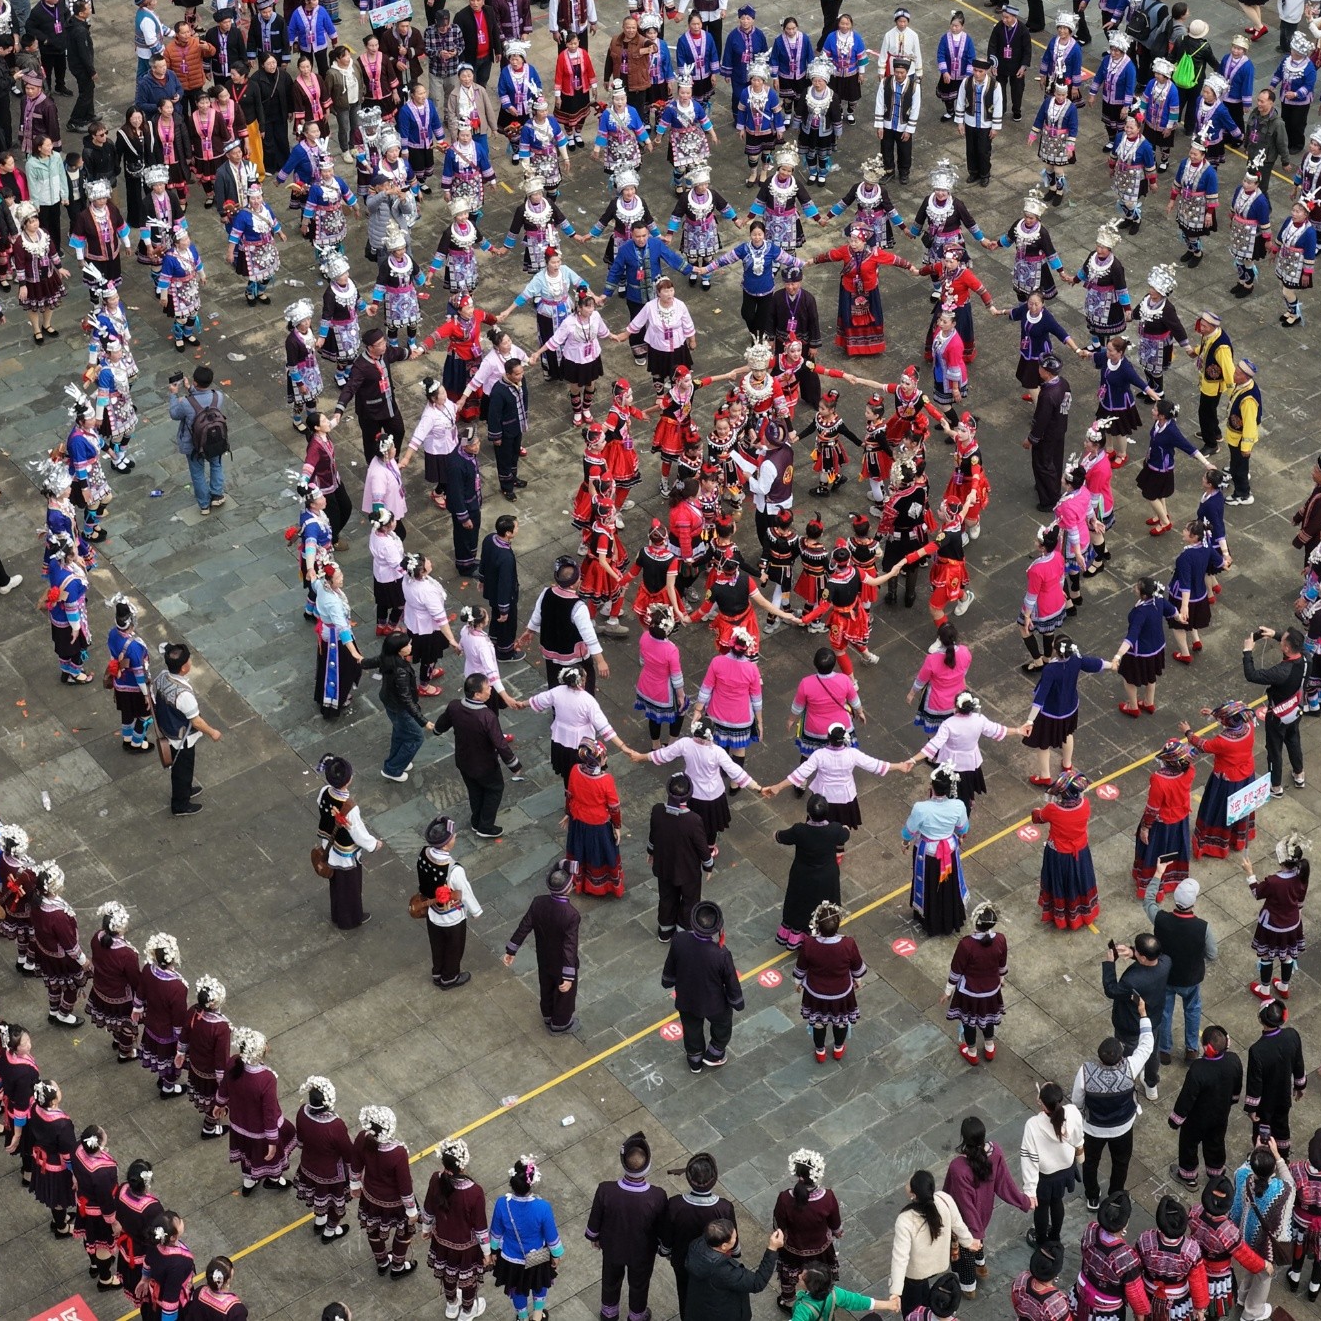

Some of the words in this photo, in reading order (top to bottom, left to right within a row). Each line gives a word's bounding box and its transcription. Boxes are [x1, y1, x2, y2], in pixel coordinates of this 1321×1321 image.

[1099, 785, 1117, 798] 14
[1020, 825, 1038, 840] 15
[895, 940, 915, 954] 17
[761, 971, 780, 987] 18
[662, 1024, 682, 1039] 19
